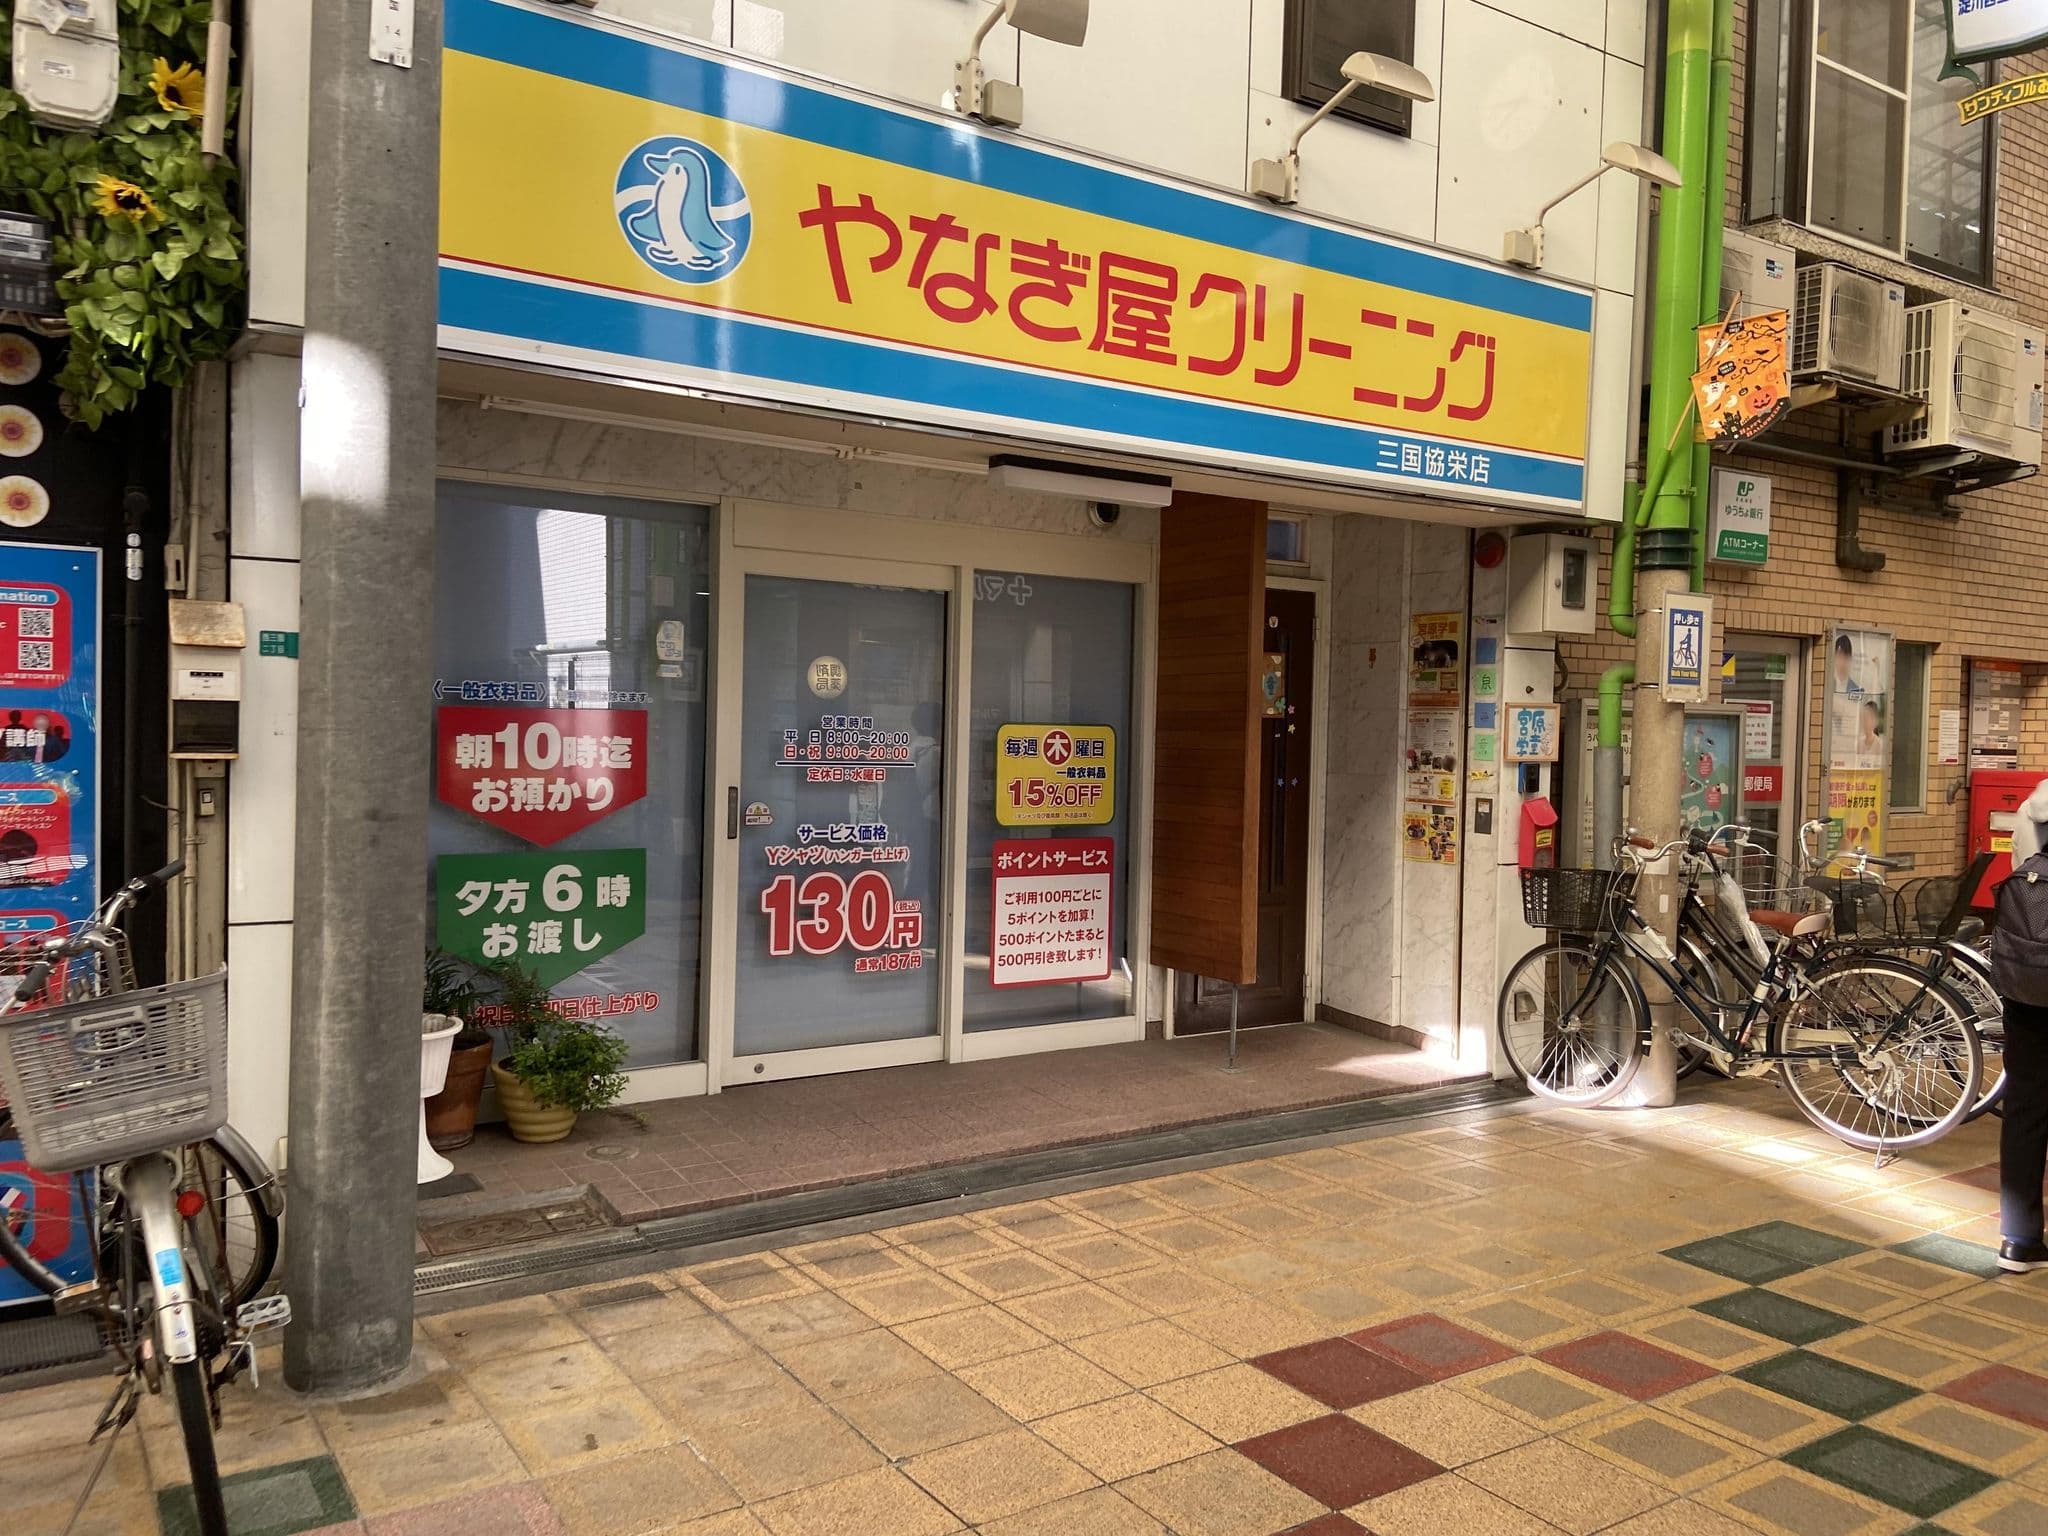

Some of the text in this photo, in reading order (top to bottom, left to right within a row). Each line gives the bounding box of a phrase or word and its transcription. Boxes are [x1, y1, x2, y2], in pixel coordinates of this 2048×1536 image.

[799, 184, 1499, 422] やなぎ屋クリーニング
[1375, 437, 1492, 486] 三国協栄店
[1724, 504, 1765, 520] ゆうちょ銀行
[1674, 613, 1700, 626] 押し歩き
[821, 716, 874, 729] 営業時間
[455, 722, 633, 771] 朝10時迄
[1005, 729, 1105, 766] 毎週木曜日
[1056, 766, 1107, 779] 一般衣料品
[1007, 778, 1103, 808] 15%OFF
[1744, 776, 1773, 792] 郵便局
[471, 777, 615, 813] お預かり
[798, 824, 888, 842] サービス価格
[997, 850, 1109, 870] ポイントサービス
[1004, 889, 1103, 906] ご利用100円ごとに
[482, 918, 602, 959] お渡し
[999, 928, 1105, 946] 500ポイントたまると
[855, 953, 922, 972] 通常187円
